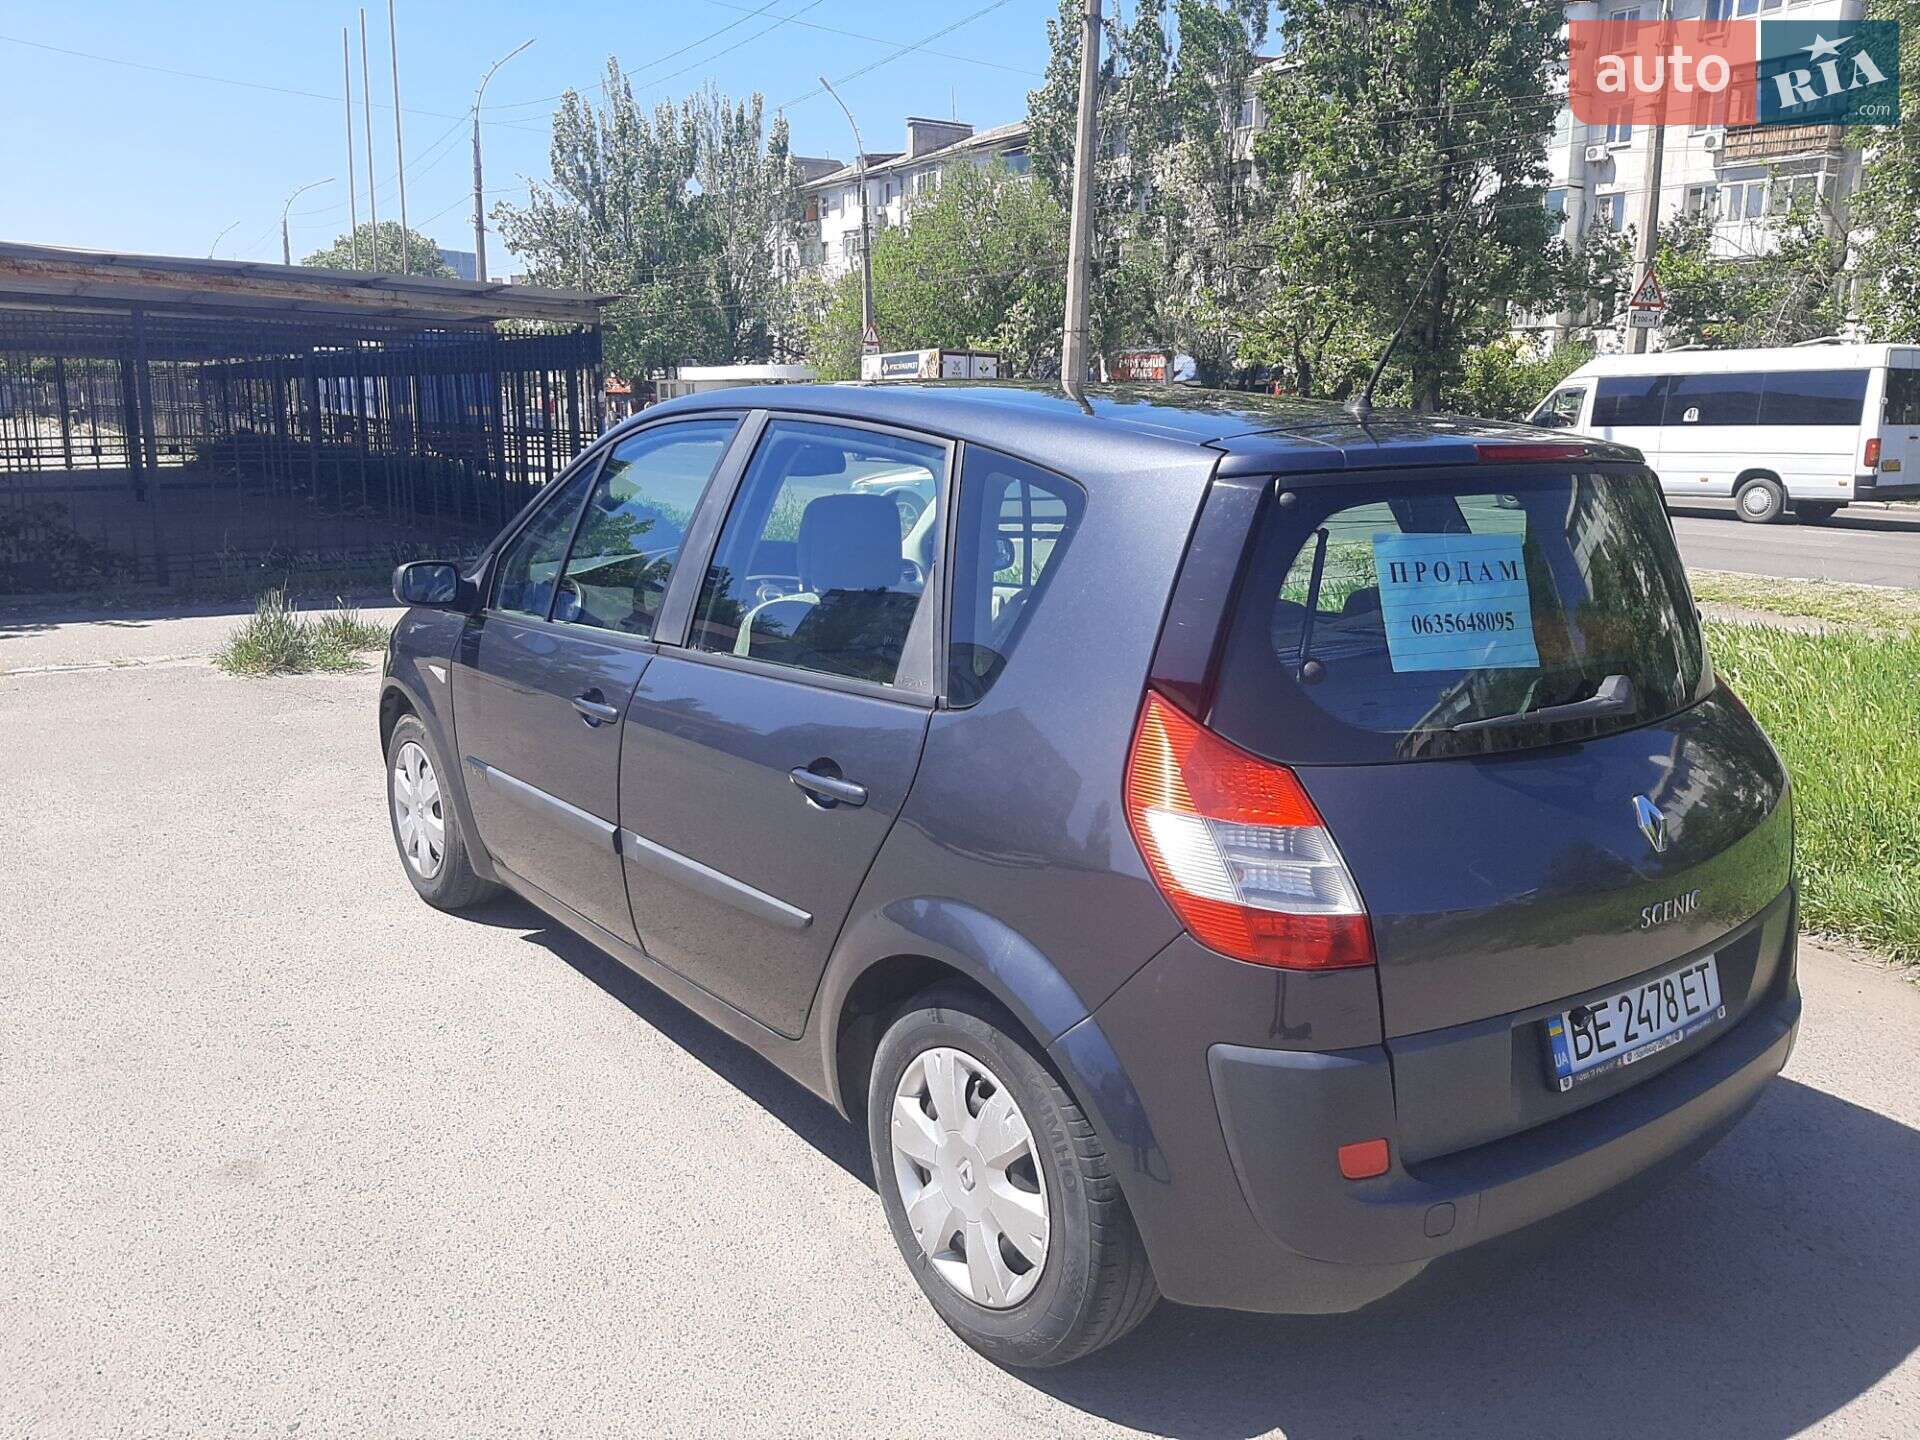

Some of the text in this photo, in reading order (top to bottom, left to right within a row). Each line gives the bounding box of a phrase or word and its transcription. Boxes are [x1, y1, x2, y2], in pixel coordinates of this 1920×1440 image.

[1389, 560, 1520, 586] ПРОДАМ
[1411, 611, 1515, 635] 0635648095
[1641, 889, 1701, 929] SCENIC
[1554, 1052, 1569, 1068] UA
